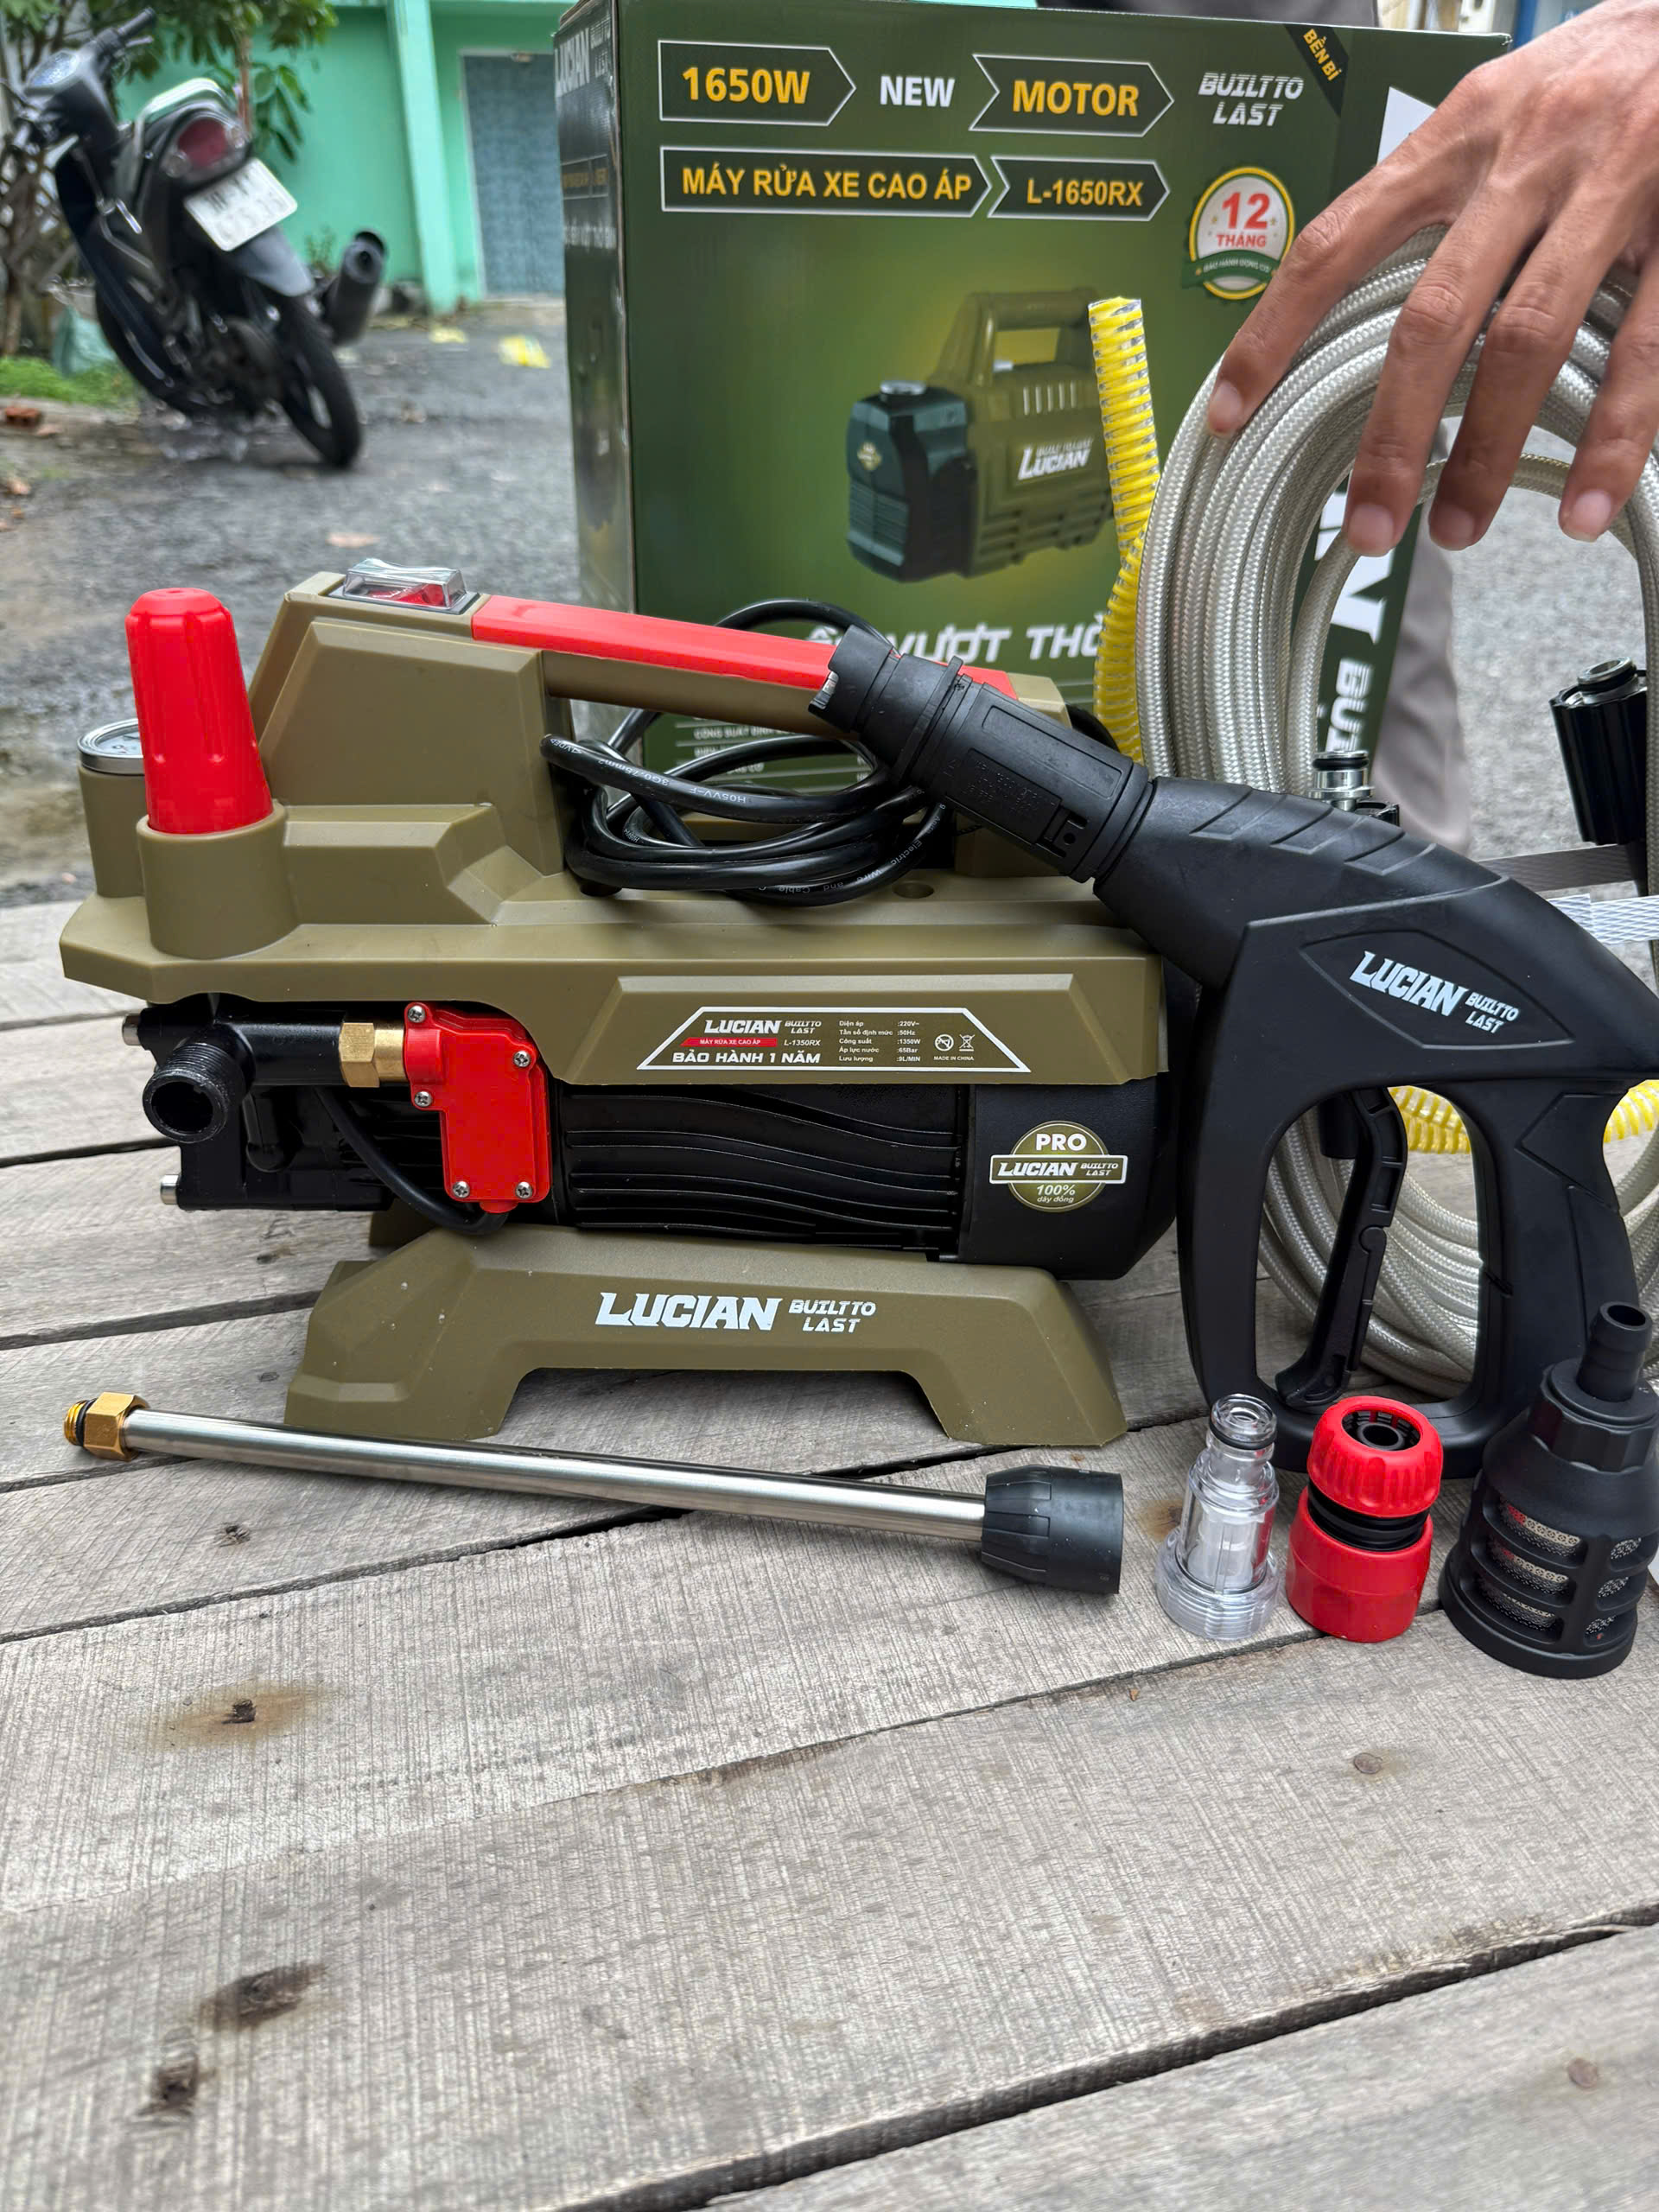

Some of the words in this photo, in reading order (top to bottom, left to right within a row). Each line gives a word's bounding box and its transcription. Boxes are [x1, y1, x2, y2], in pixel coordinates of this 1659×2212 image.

[682, 67, 810, 104] 1650W
[880, 75, 956, 107] NEW
[1013, 80, 1140, 117] MOTOR
[1212, 101, 1284, 127] LAST
[682, 162, 745, 195] MÁY
[753, 163, 817, 197] RỬA
[823, 170, 861, 198] XE
[868, 172, 928, 200] CAO
[934, 168, 973, 200] ÁP
[1027, 179, 1144, 207] L-1650RX
[1221, 193, 1270, 230] 12
[1217, 232, 1267, 248] THÁNG
[1349, 950, 1470, 1017] LUCIAN
[704, 1020, 782, 1034] LUCIAN
[1465, 1010, 1505, 1034] LAST
[672, 1049, 709, 1063] BẢO
[715, 1049, 764, 1064] HÀNH
[769, 1052, 776, 1063] 1
[781, 1050, 821, 1064] NĂM
[1036, 1133, 1087, 1151] PRO
[997, 1162, 1078, 1177] LUCIAN
[1037, 1184, 1076, 1196] 100%
[594, 1292, 783, 1331] LUCIAN
[802, 1316, 861, 1333] LAST
